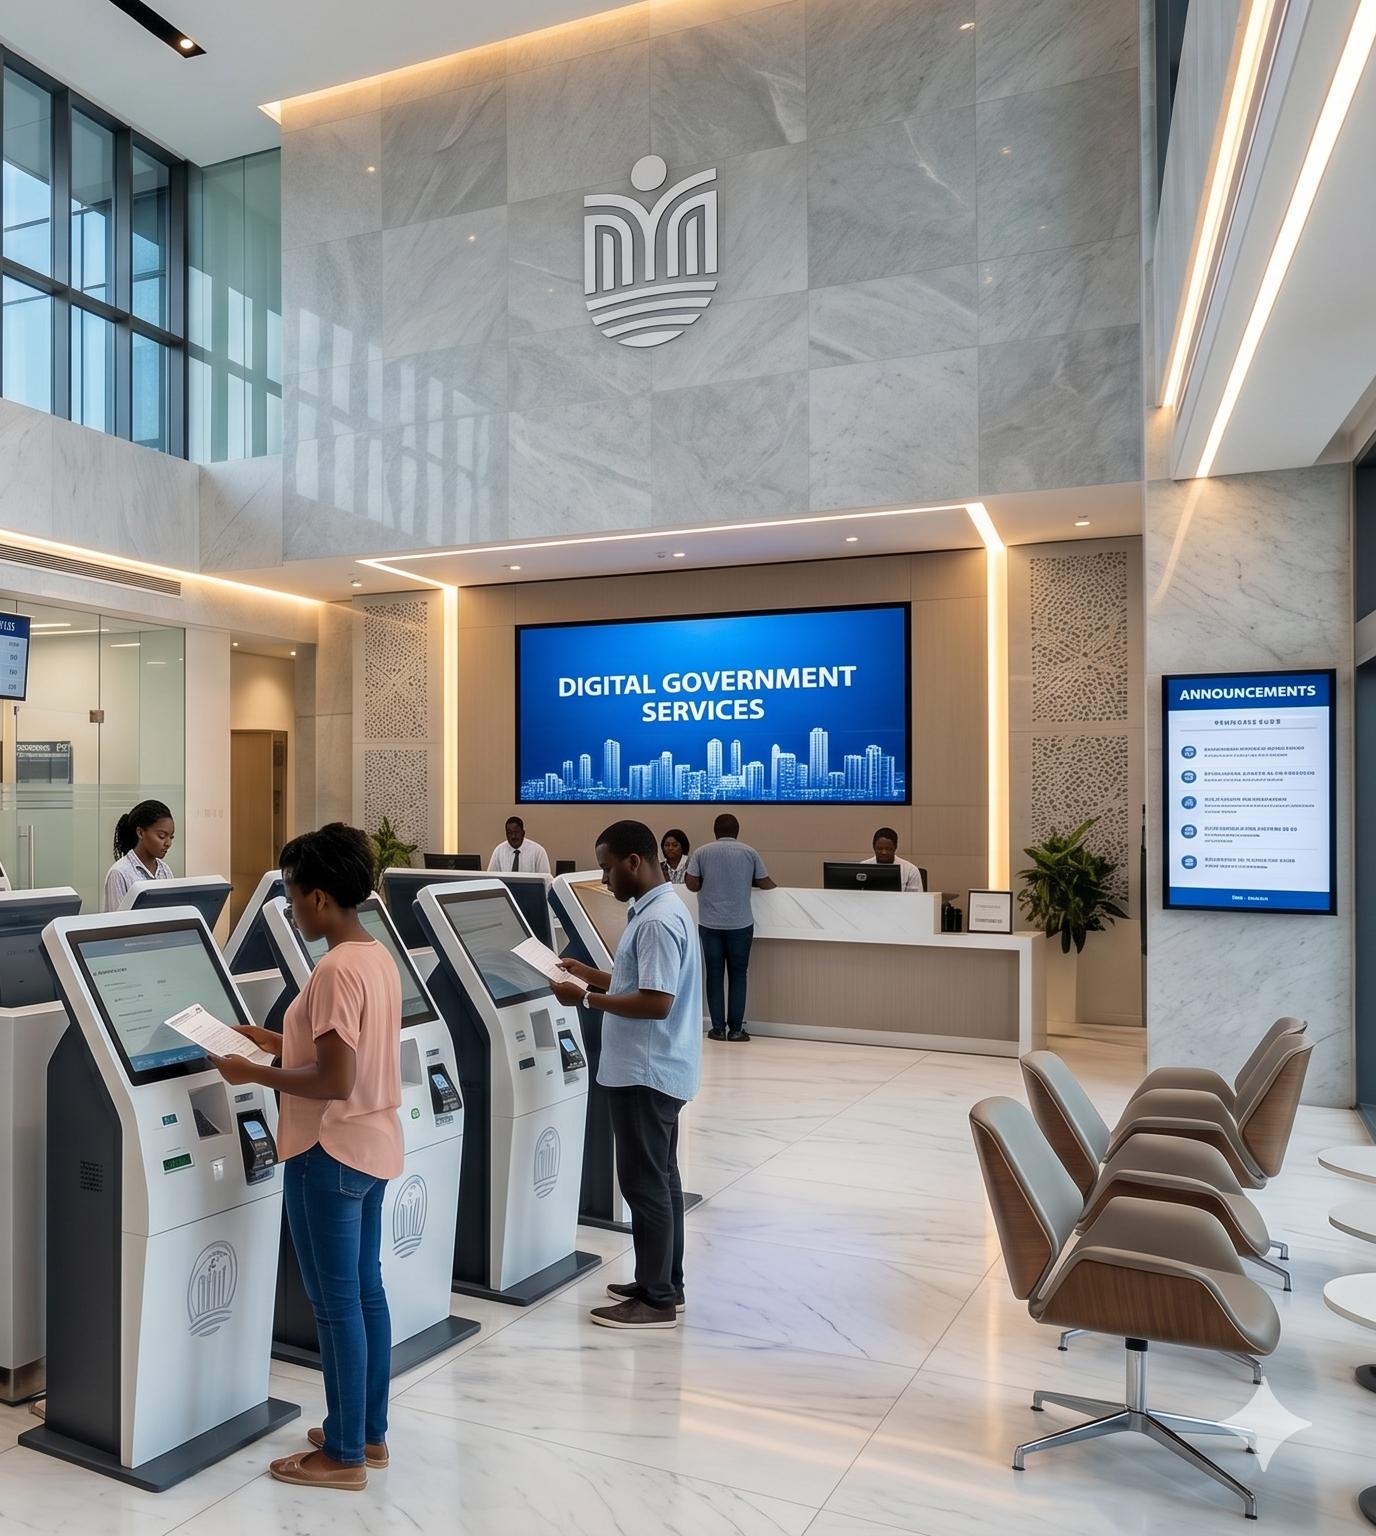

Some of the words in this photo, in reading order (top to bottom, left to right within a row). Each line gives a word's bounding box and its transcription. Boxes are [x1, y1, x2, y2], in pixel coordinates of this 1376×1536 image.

[558, 674, 656, 698] DIGITAL
[662, 665, 857, 694] GOVERNMENT
[1179, 685, 1317, 701] ANNOUNCEMENTS
[641, 699, 765, 723] SERVICES
